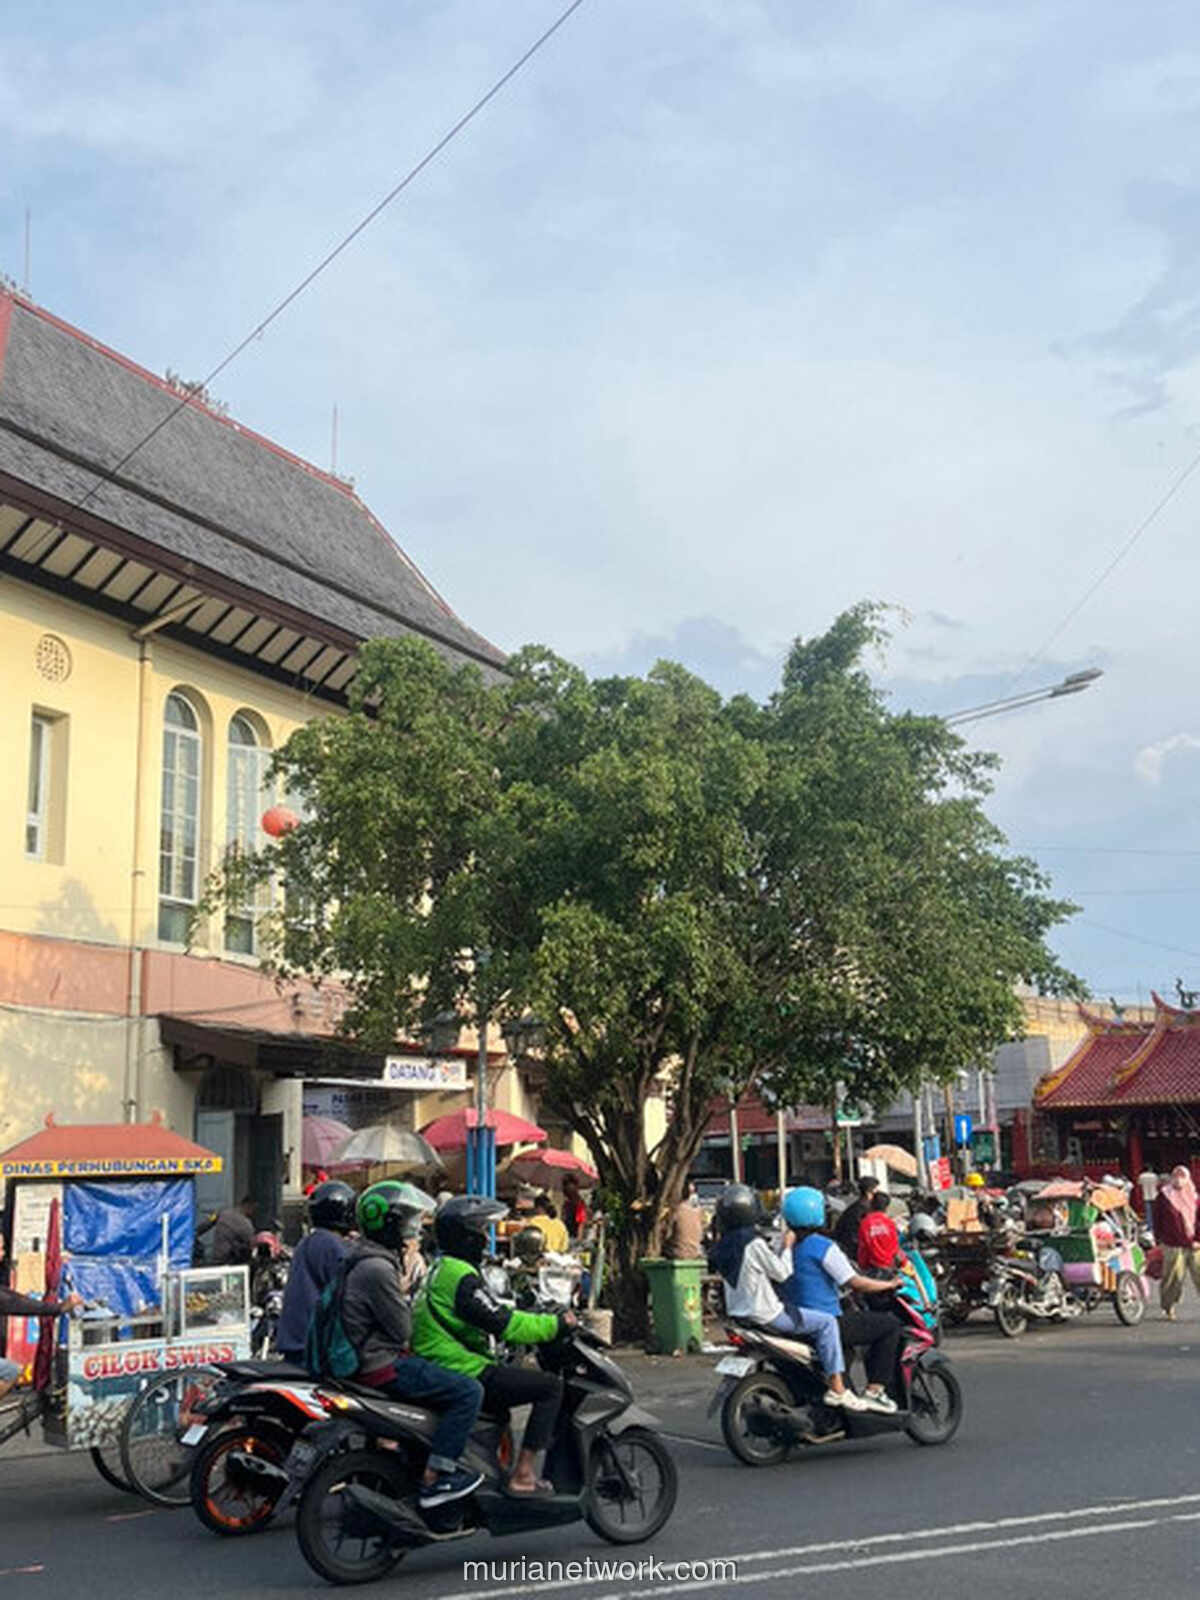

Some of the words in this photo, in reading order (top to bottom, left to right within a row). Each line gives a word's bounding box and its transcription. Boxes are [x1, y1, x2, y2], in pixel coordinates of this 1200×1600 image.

[3, 1162, 53, 1175] DINAS
[57, 1159, 178, 1174] PERHUBUNGAN
[83, 1350, 160, 1380] CILOK
[164, 1343, 236, 1369] SWISS
